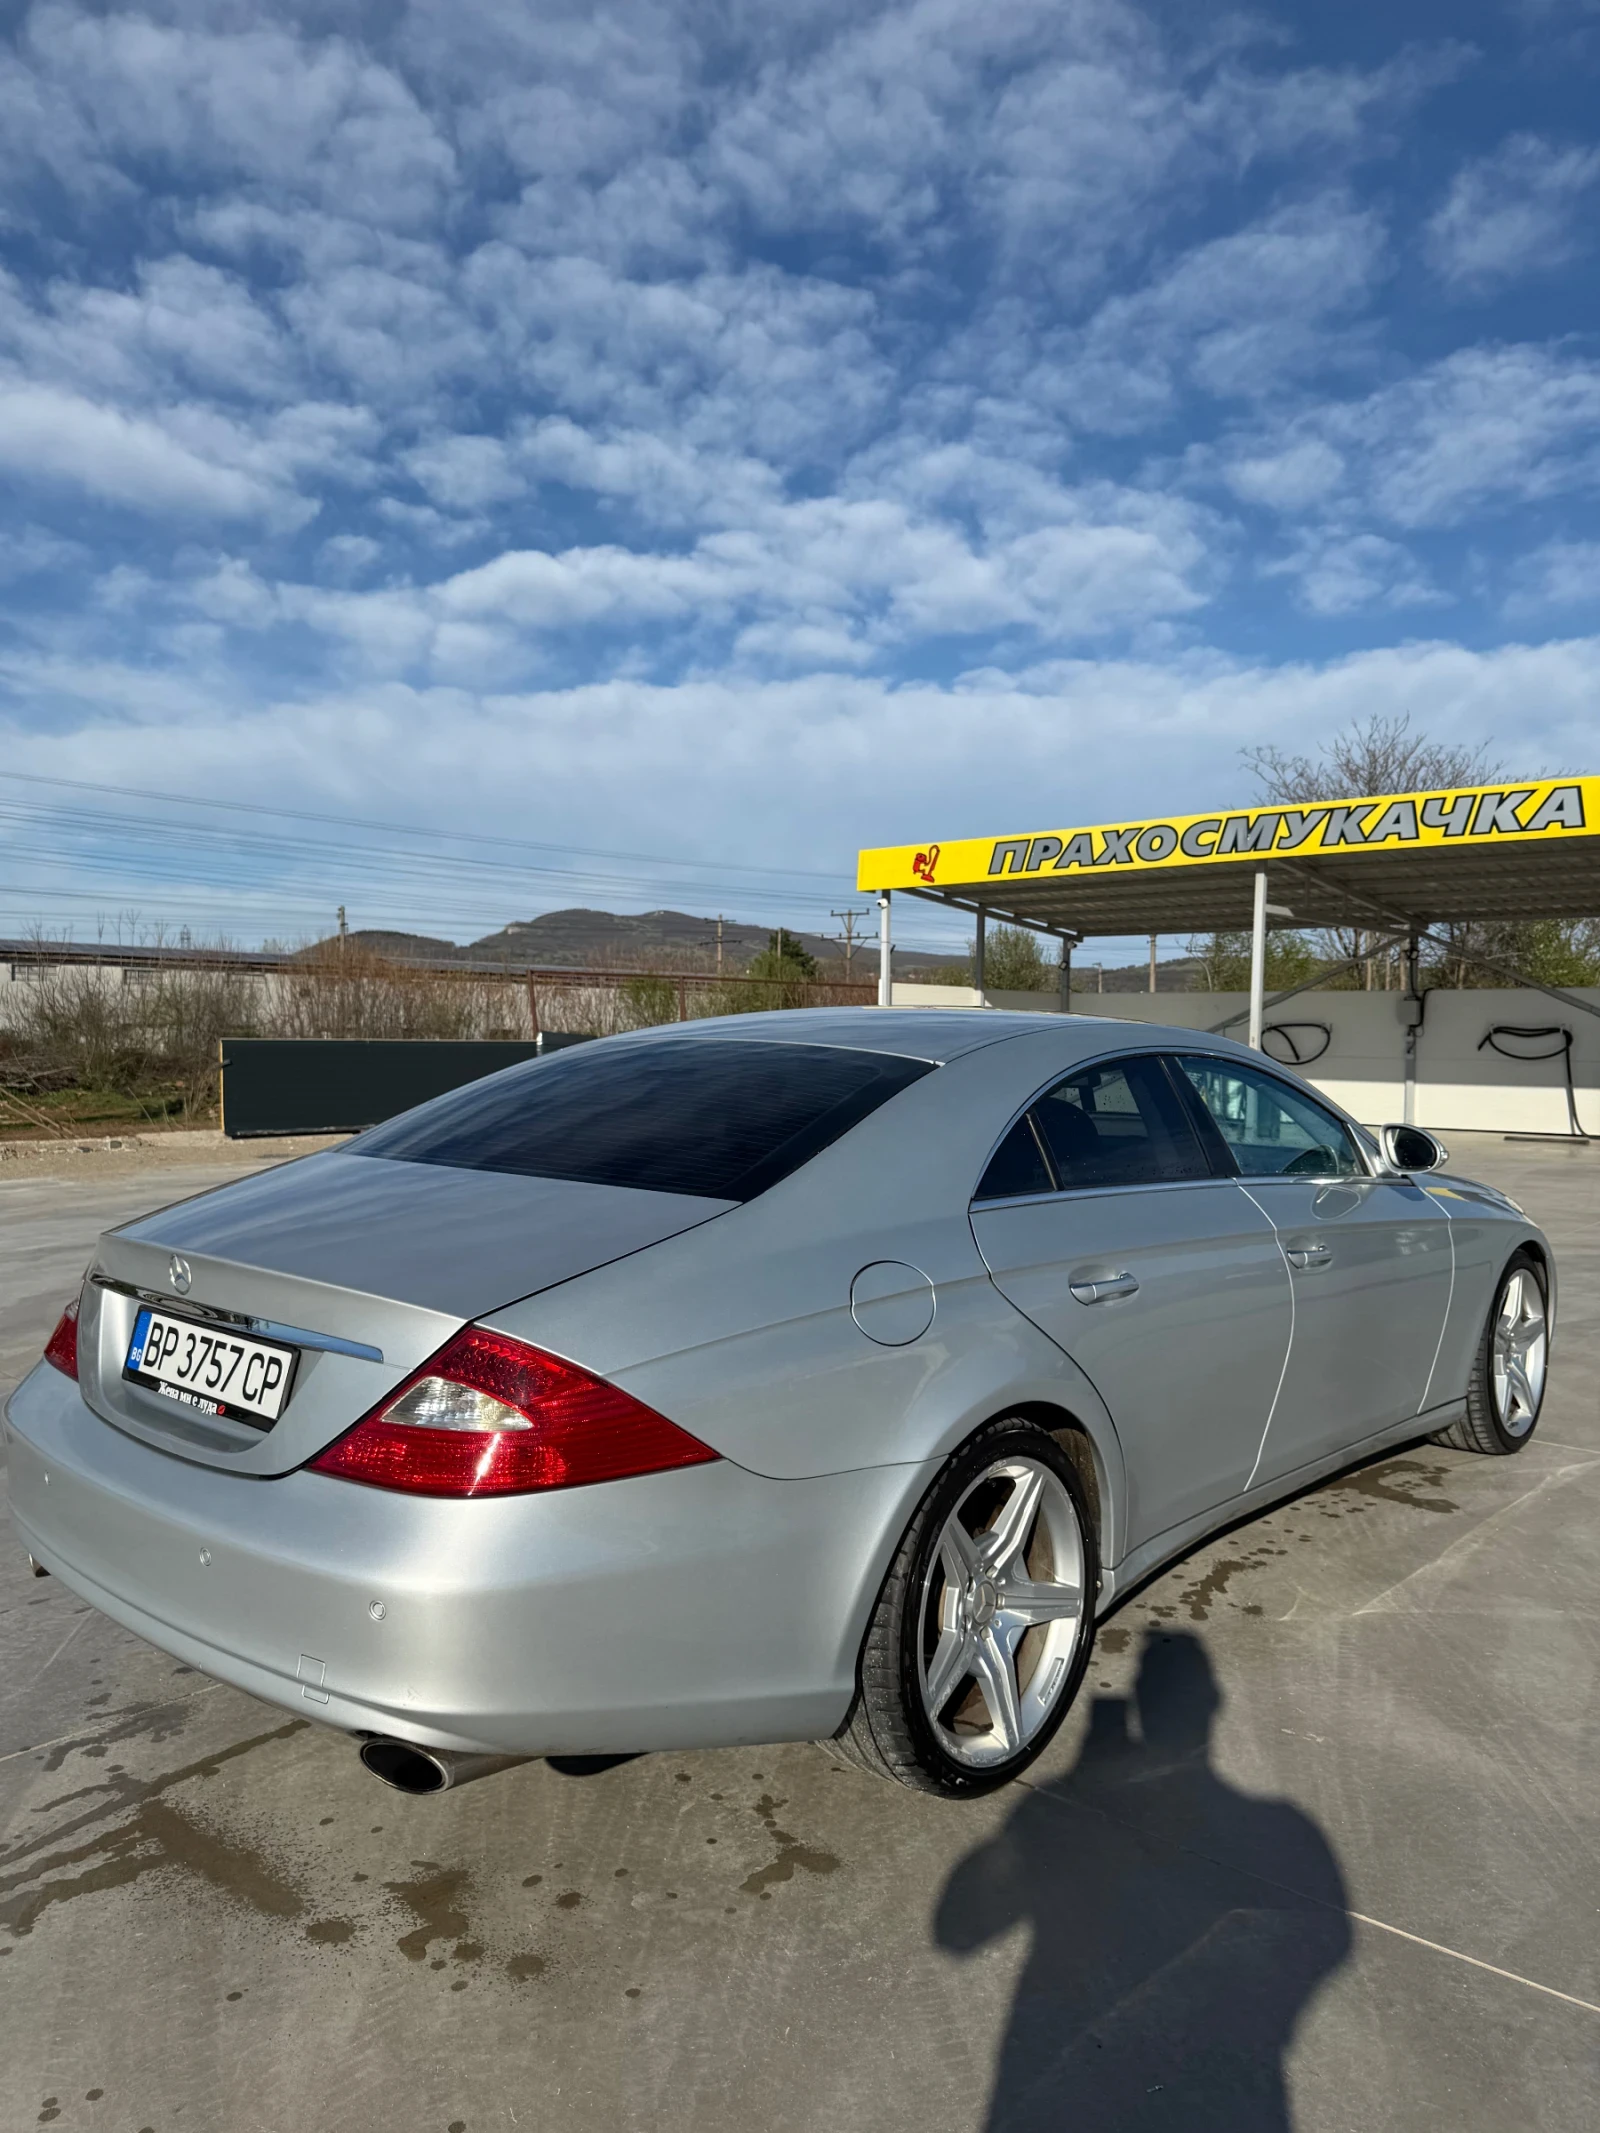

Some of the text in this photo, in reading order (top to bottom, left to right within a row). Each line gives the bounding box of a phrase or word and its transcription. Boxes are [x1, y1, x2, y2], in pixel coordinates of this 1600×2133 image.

[988, 785, 1586, 875] ПРАХОСМУКАЧКА
[131, 1347, 142, 1362] BG
[143, 1321, 283, 1405] BP 3757 CP
[158, 1381, 217, 1415] Жена ми е луда
